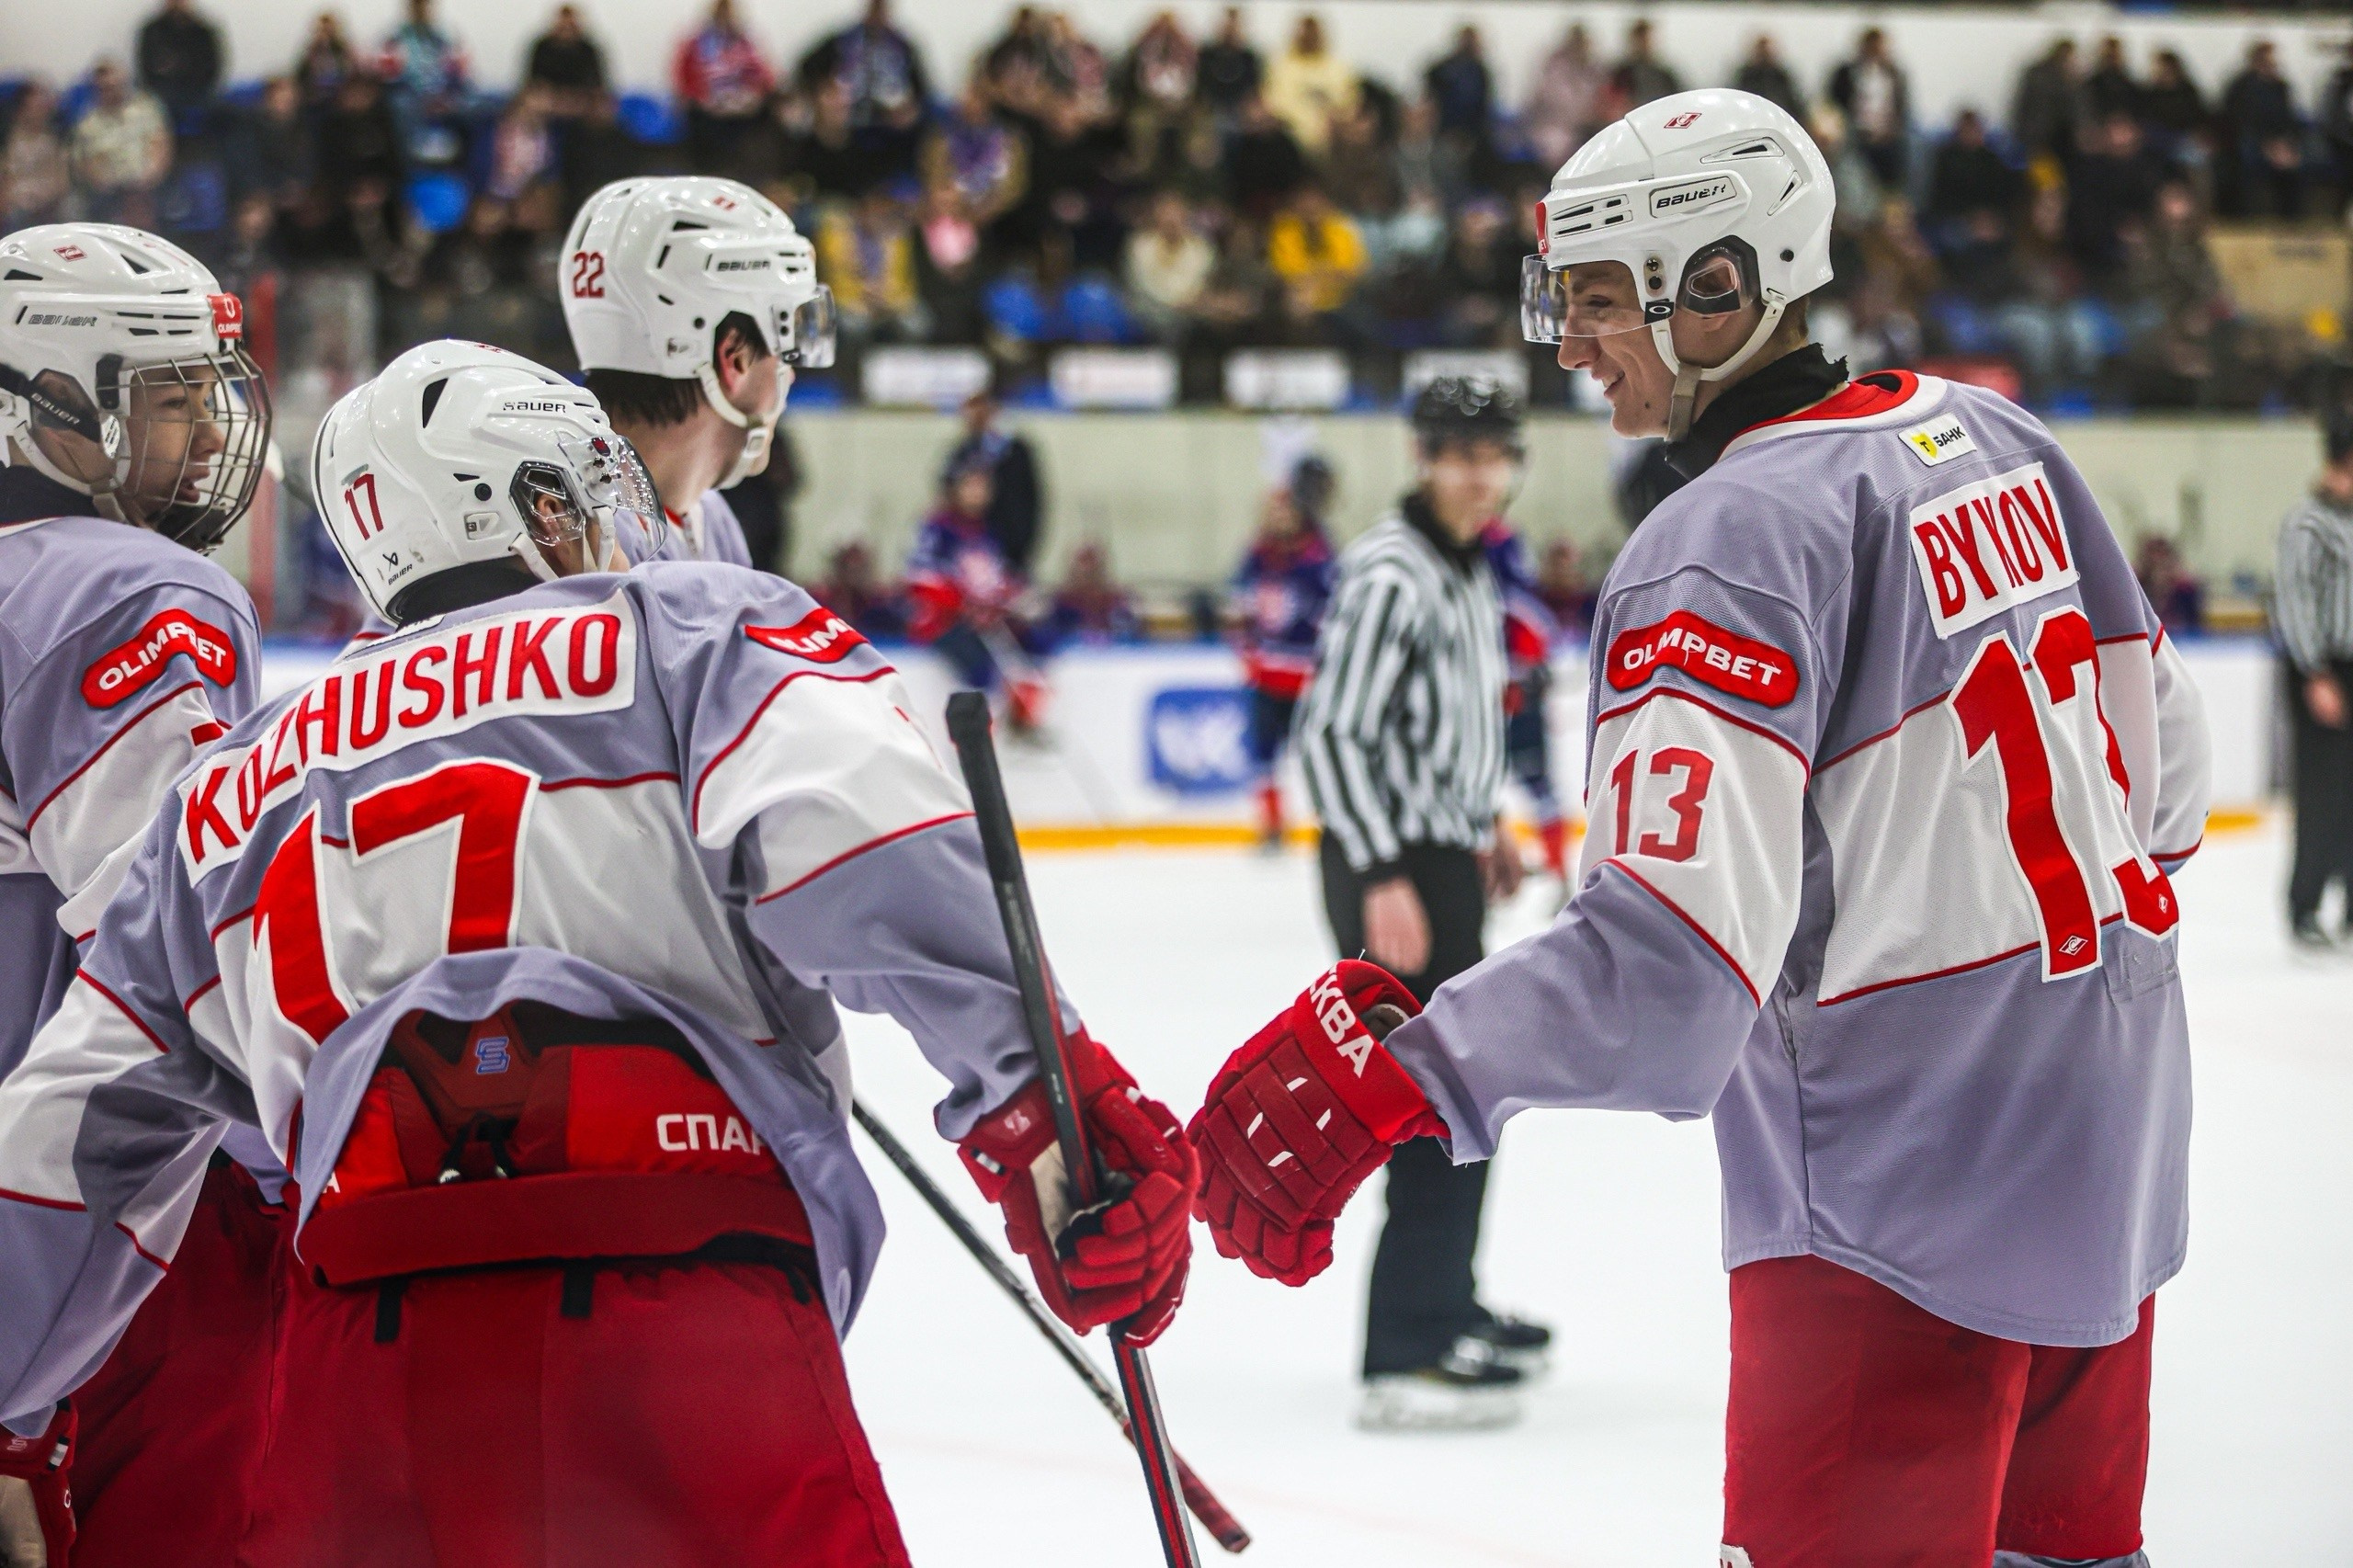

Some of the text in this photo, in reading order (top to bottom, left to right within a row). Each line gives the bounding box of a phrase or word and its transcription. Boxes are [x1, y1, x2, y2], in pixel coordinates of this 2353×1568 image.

[573, 251, 605, 299] 22
[1932, 426, 1966, 448] БАНК
[344, 472, 384, 541] 17
[1913, 478, 2070, 620] BYKOV
[186, 612, 621, 865] KOZHUSHKO
[1947, 610, 2180, 980] 13
[1609, 746, 1715, 863] 13
[251, 759, 537, 1048] 17
